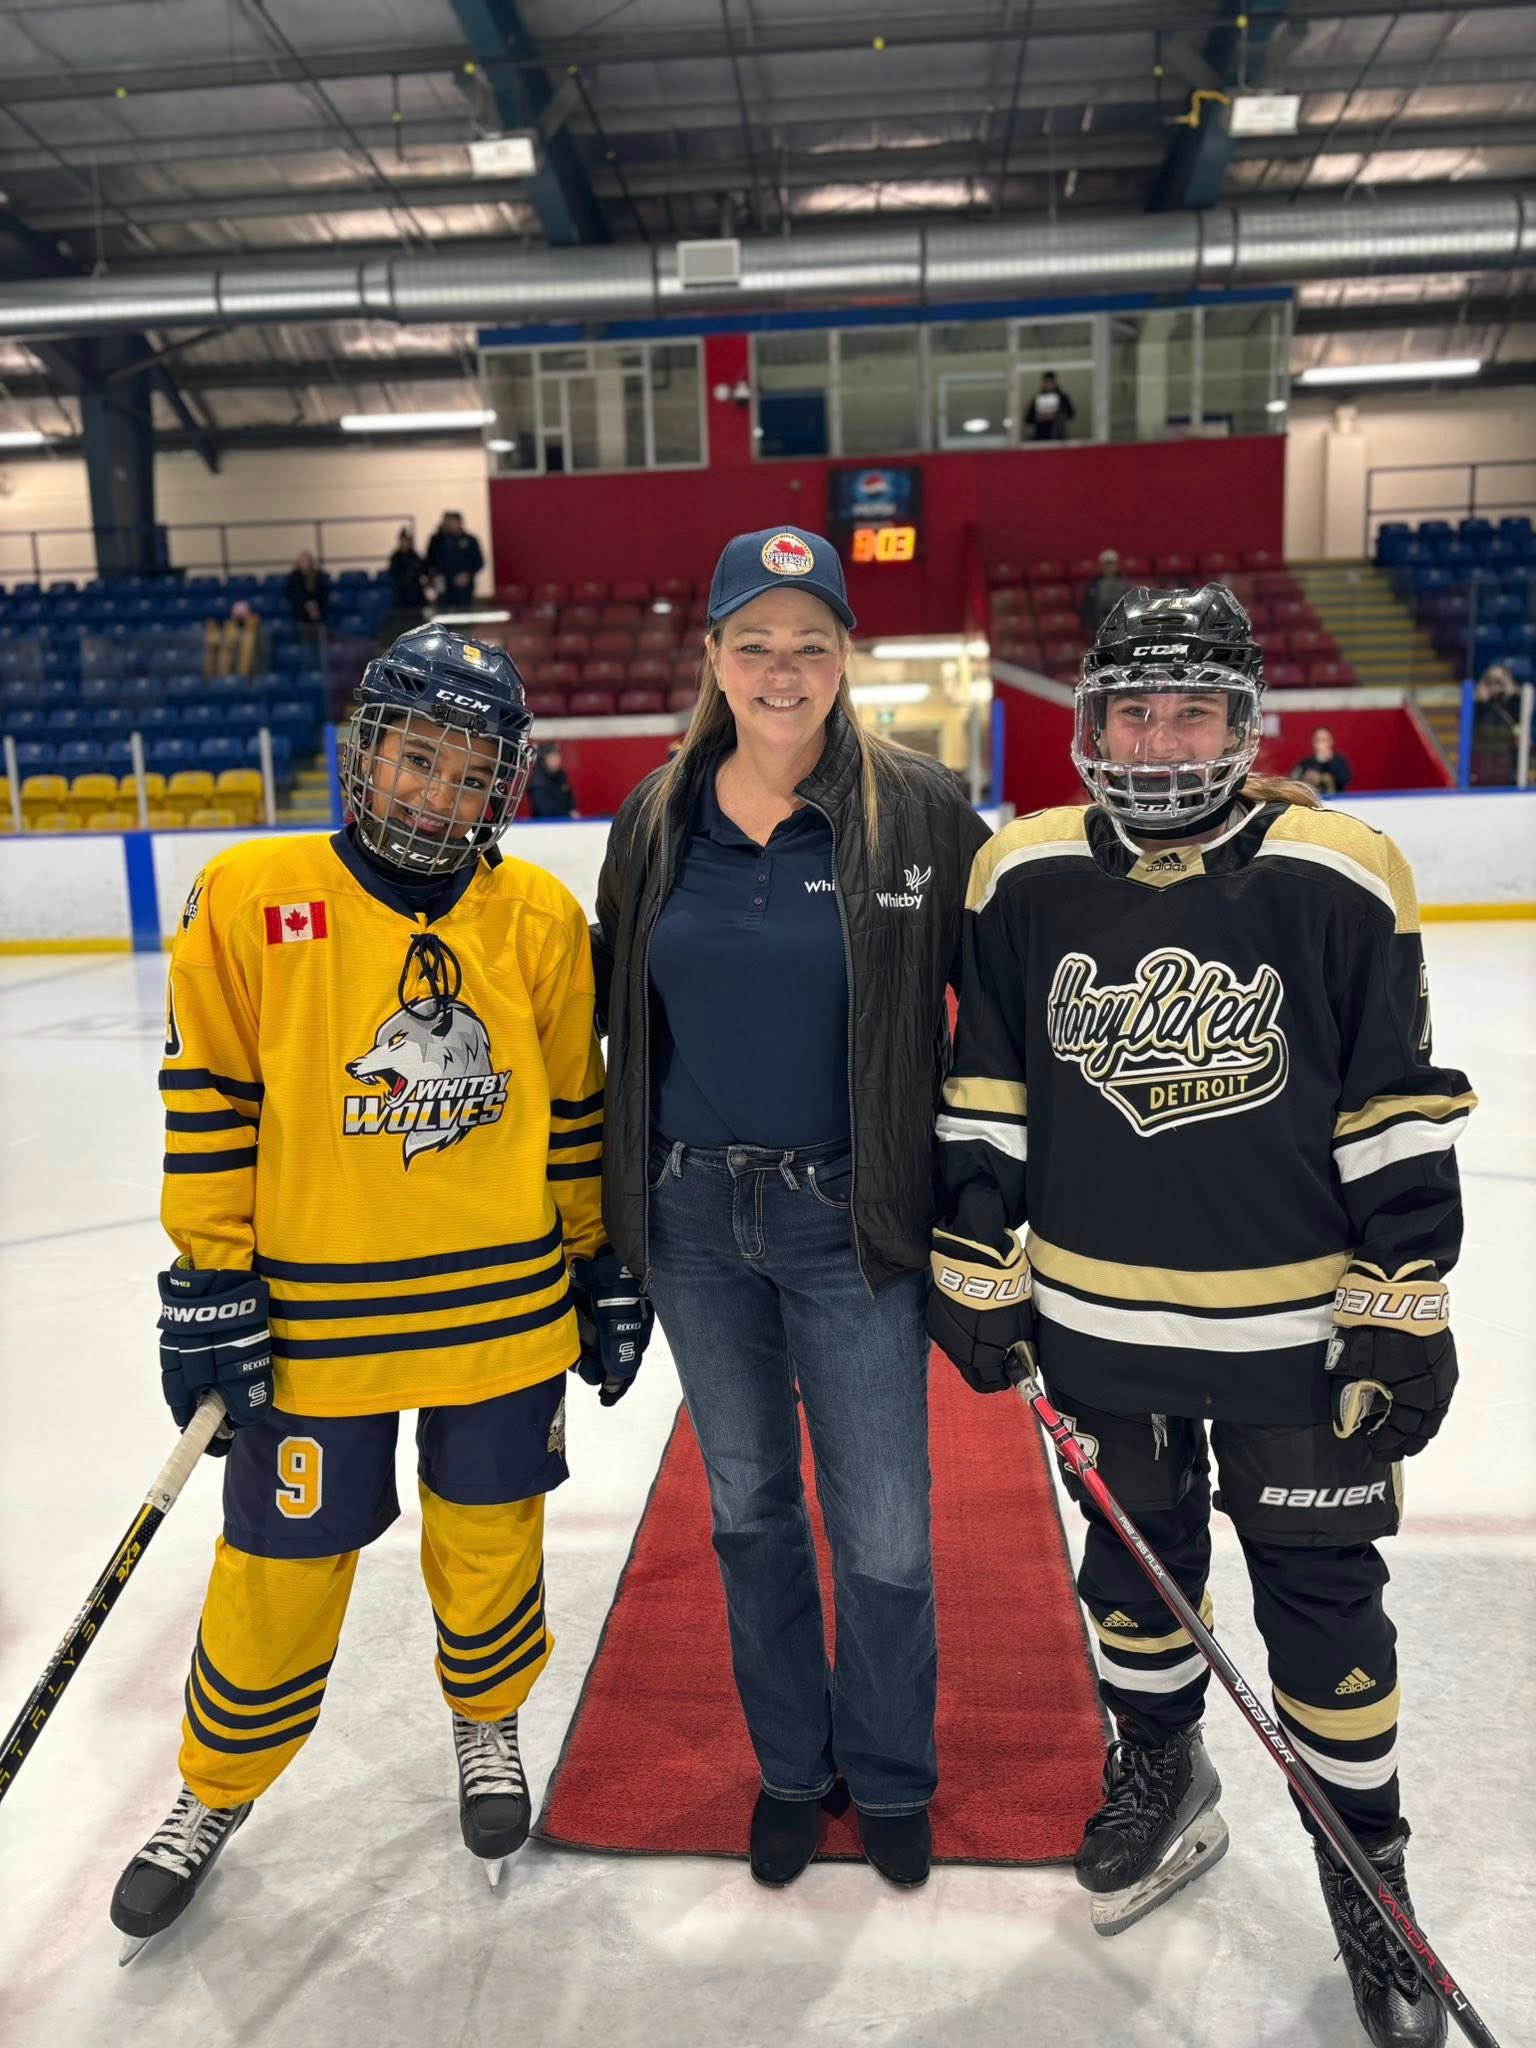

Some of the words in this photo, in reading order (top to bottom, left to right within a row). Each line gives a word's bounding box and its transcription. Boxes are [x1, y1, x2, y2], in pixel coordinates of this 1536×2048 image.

[463, 644, 482, 664] 9
[435, 688, 492, 713] CCM
[1145, 863, 1187, 872] adidas
[876, 892, 924, 910] Whitby
[416, 1070, 512, 1101] WHITBY
[1150, 1074, 1249, 1110] DETROIT
[344, 1091, 508, 1135] WOLVES
[276, 1436, 323, 1519] 9
[1258, 1481, 1387, 1508] BAUER
[1144, 1553, 1166, 1579] FLEX
[1102, 1620, 1139, 1628] adidas
[1334, 1679, 1376, 1695] adidas
[1241, 1693, 1296, 1764] BAUER
[1376, 1881, 1435, 1973] VAPOR
